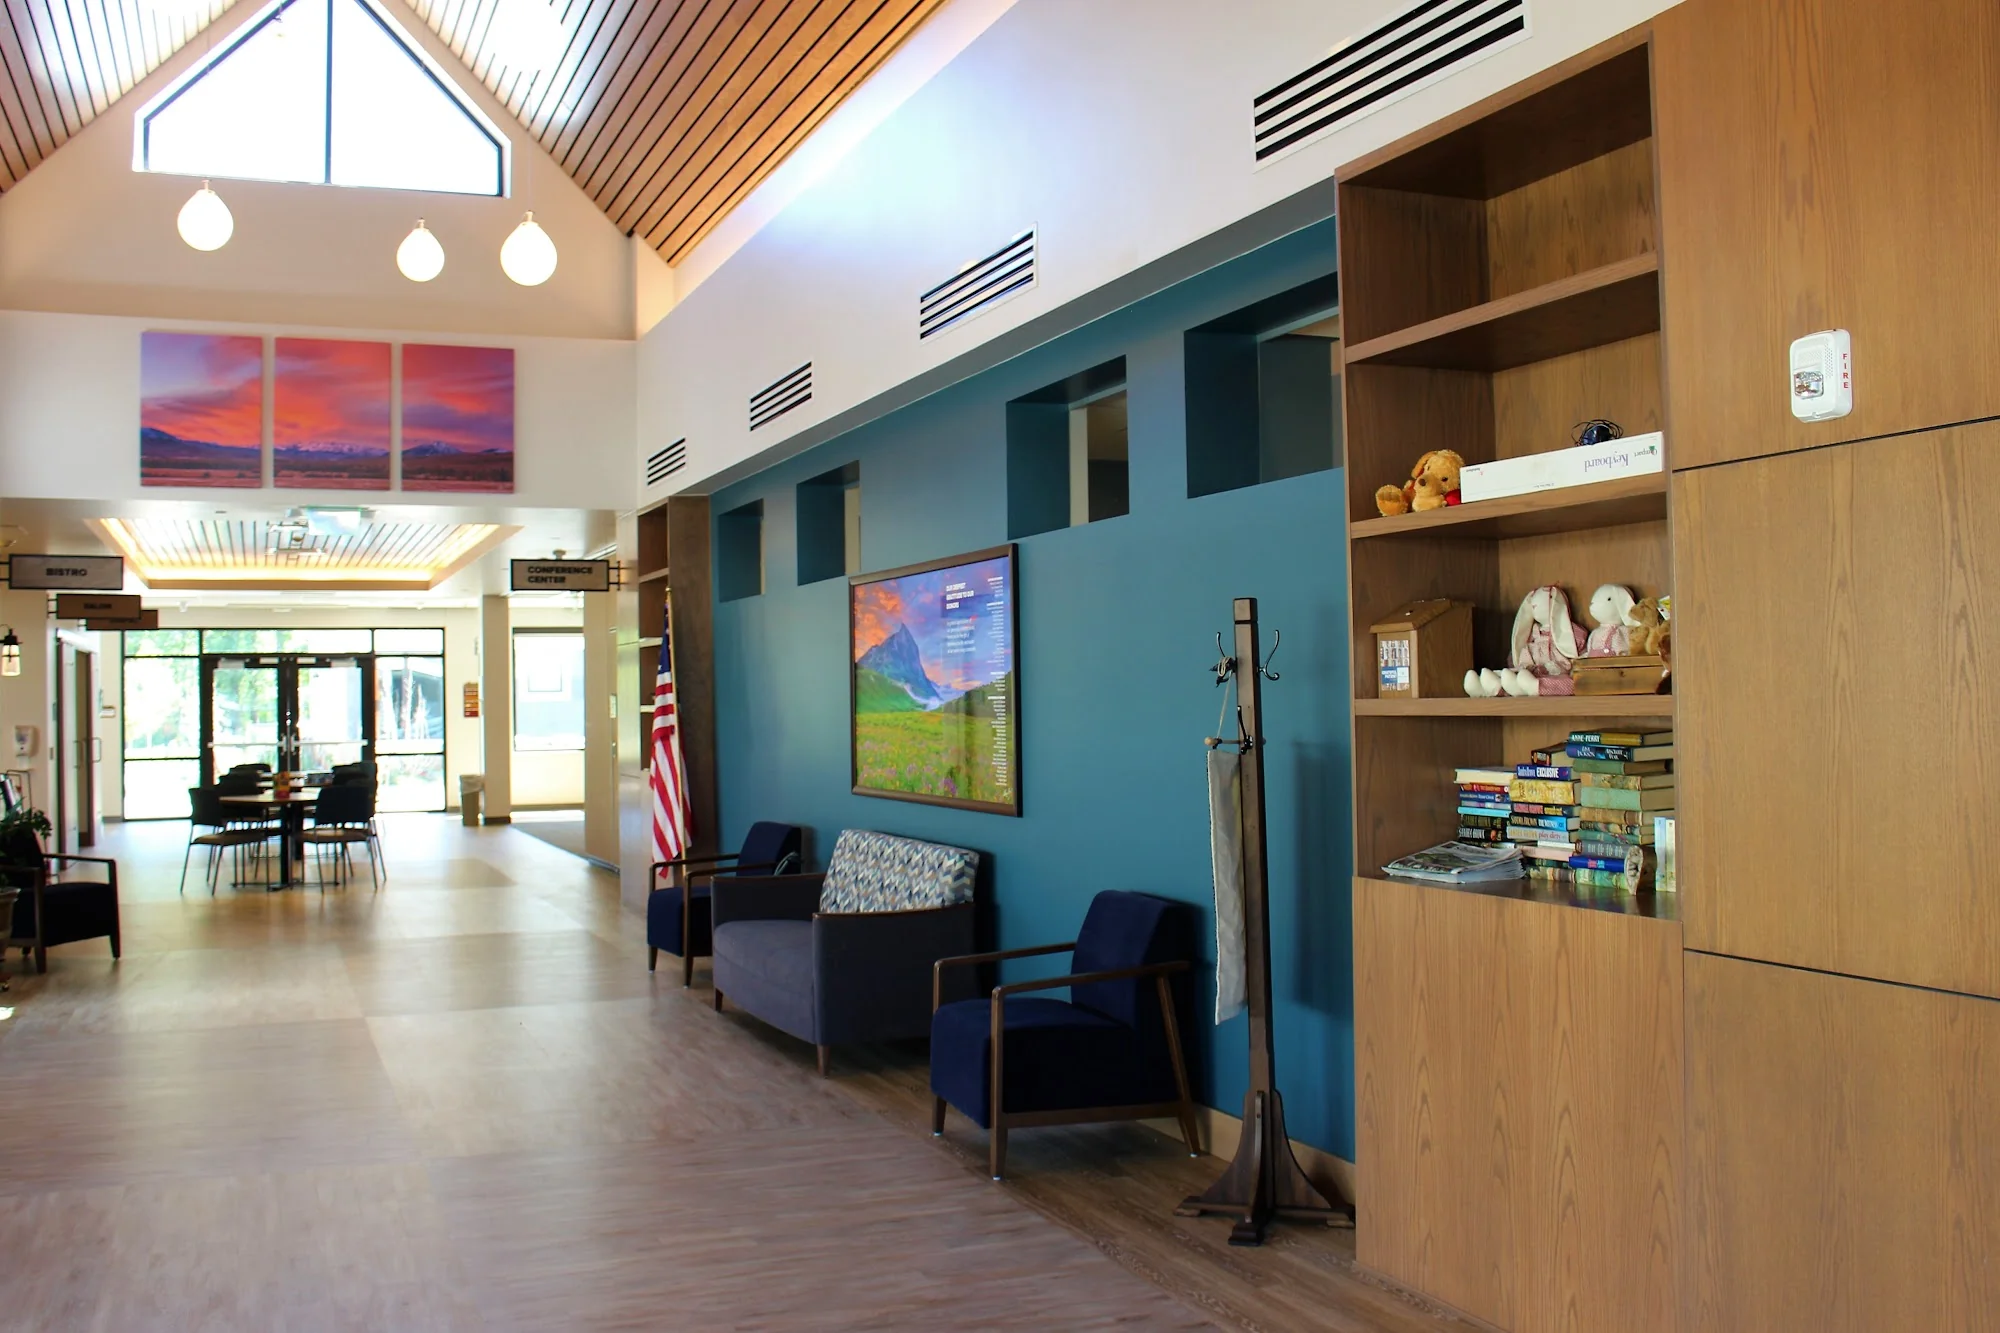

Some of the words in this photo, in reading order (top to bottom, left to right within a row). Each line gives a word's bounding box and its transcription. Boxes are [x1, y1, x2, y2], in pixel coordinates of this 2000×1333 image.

[1584, 453, 1629, 472] Keyboard
[45, 568, 88, 577] BISTRO
[528, 566, 593, 574] CONFERENCE
[1536, 767, 1559, 778] EXCLUSIVE
